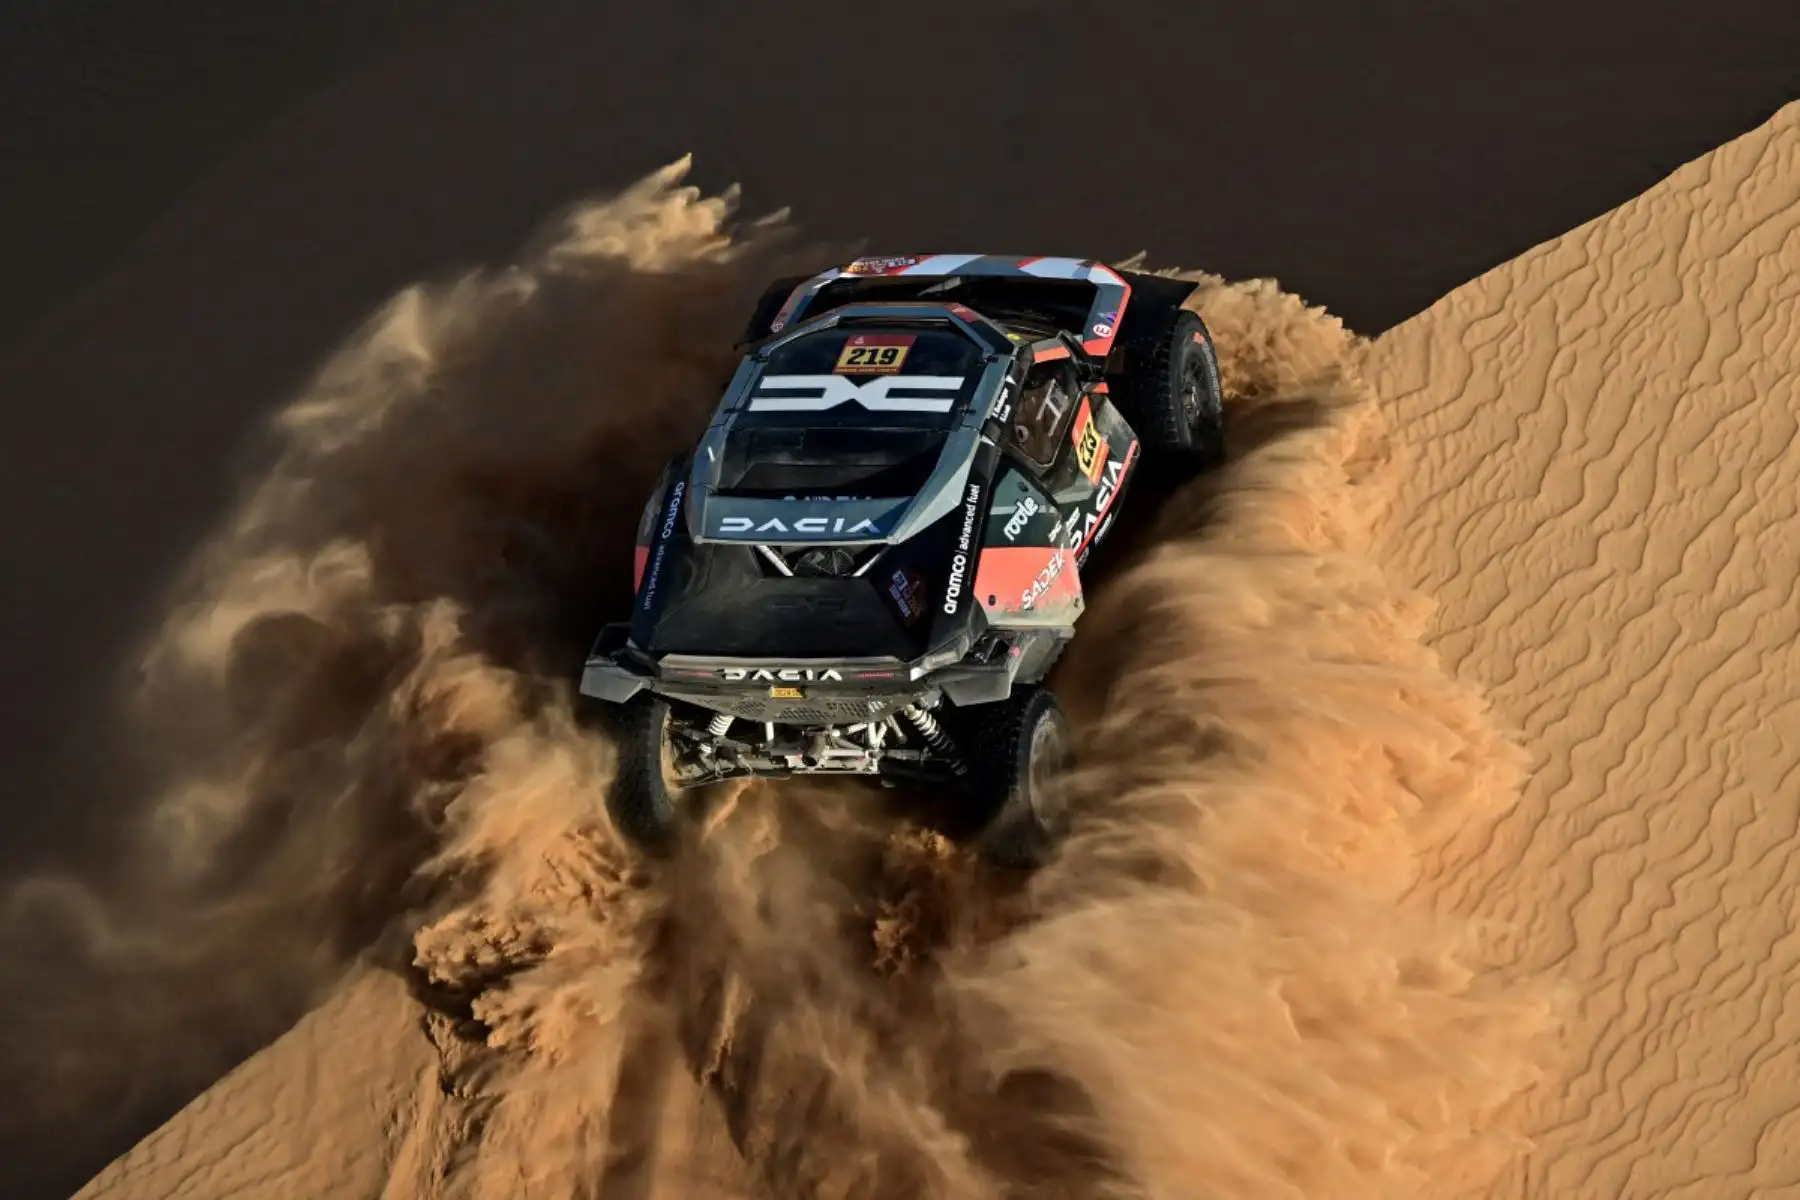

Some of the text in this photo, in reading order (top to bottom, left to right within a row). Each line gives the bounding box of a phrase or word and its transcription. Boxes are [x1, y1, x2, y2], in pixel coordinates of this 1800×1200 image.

[846, 348, 899, 365] 219
[662, 481, 685, 539] aramco
[719, 517, 881, 533] DACIA
[944, 483, 981, 614] aramco advanced fuel
[723, 668, 843, 681] DACIA
